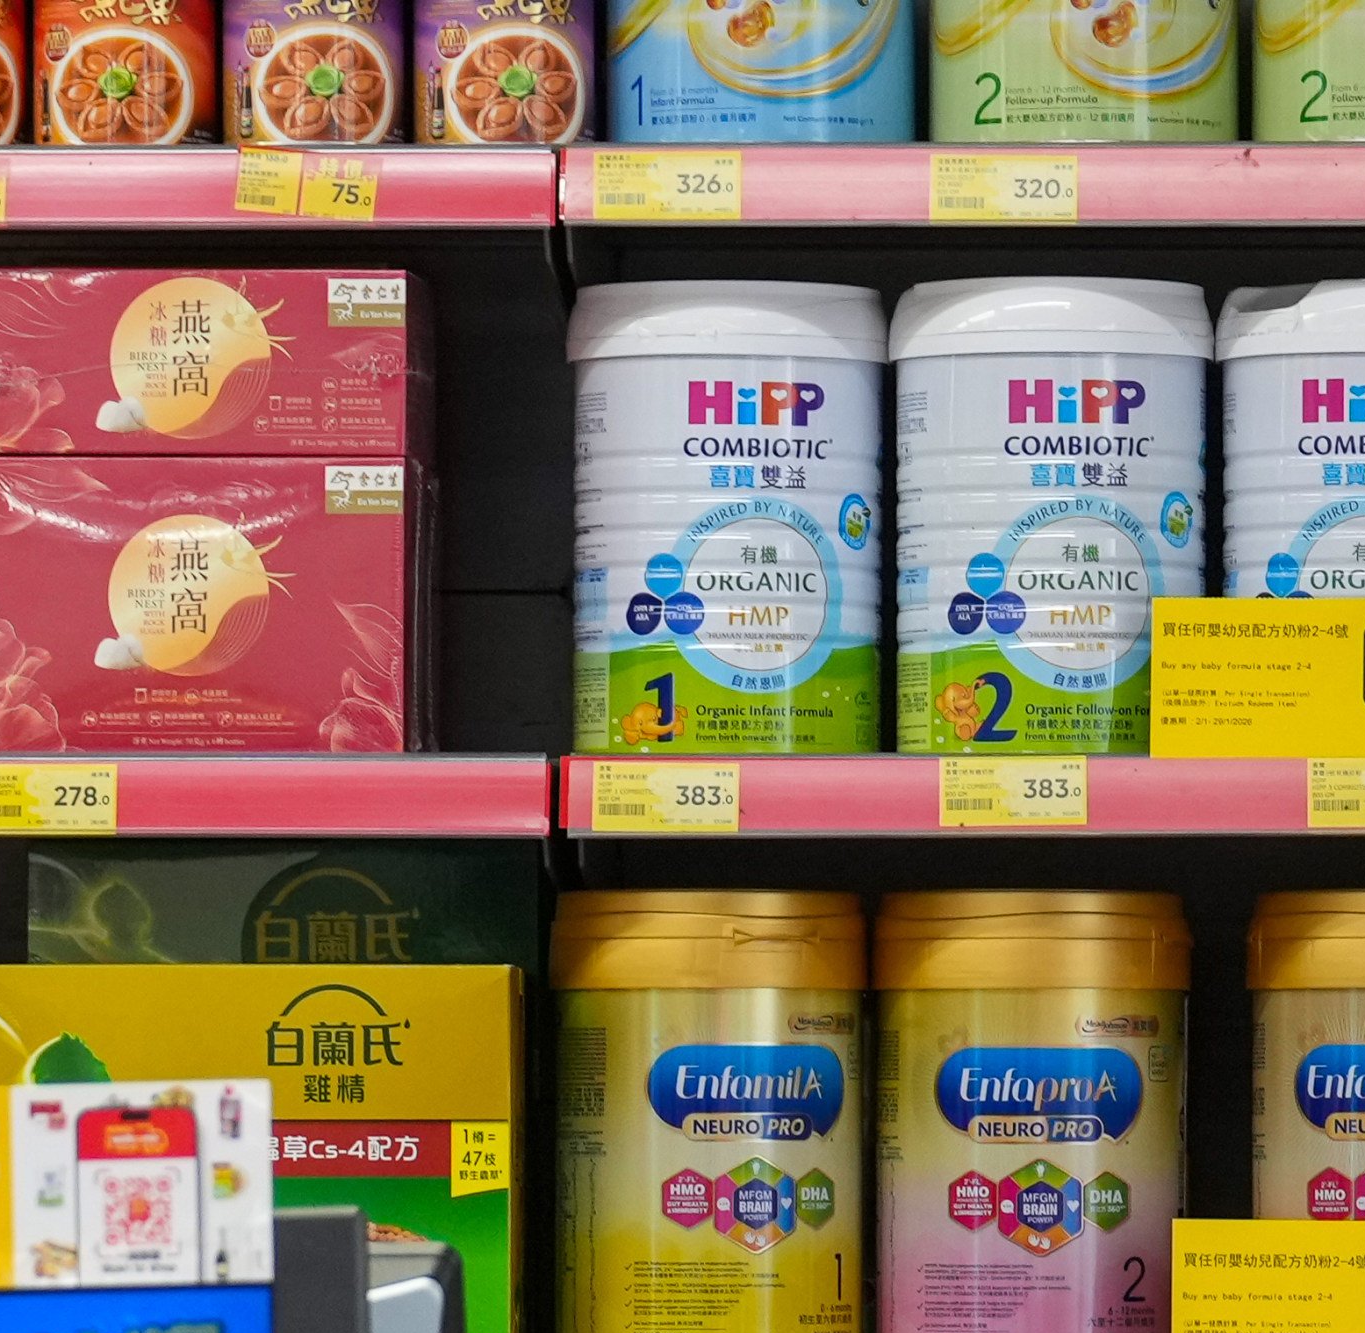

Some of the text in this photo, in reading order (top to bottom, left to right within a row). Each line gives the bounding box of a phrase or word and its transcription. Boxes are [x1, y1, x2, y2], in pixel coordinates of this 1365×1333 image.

[631, 75, 644, 127] 1
[973, 72, 1003, 125] 2
[1299, 71, 1329, 124] 2
[331, 183, 371, 207] 75.0
[677, 174, 733, 194] 326.0
[1014, 179, 1074, 199] 320.0
[149, 301, 167, 347] 冰糖
[172, 298, 210, 397] 燕窩
[688, 381, 825, 427] HiPP
[1009, 379, 1146, 425] HiPP
[147, 537, 165, 585] 冰糖
[170, 531, 209, 635] 燕窩
[696, 571, 817, 593] ORGANIC
[1018, 569, 1139, 591] ORGANIC
[1161, 661, 1178, 673] Buy
[1180, 663, 1195, 673] any
[1200, 661, 1222, 673] baby
[1226, 661, 1262, 671] formula
[1296, 661, 1312, 671] 2-4
[54, 786, 110, 807] 278.0
[676, 786, 733, 805] 383.0
[1023, 779, 1081, 799] 383.0
[265, 1021, 404, 1067] 白蘭氏
[303, 1074, 365, 1104] 雞精
[693, 1118, 805, 1136] NEURO PRO
[978, 1121, 1094, 1138] NEURO PRO
[462, 1151, 497, 1167] 47枝
[670, 1184, 705, 1195] HMO
[739, 1201, 773, 1213] BRAIN
